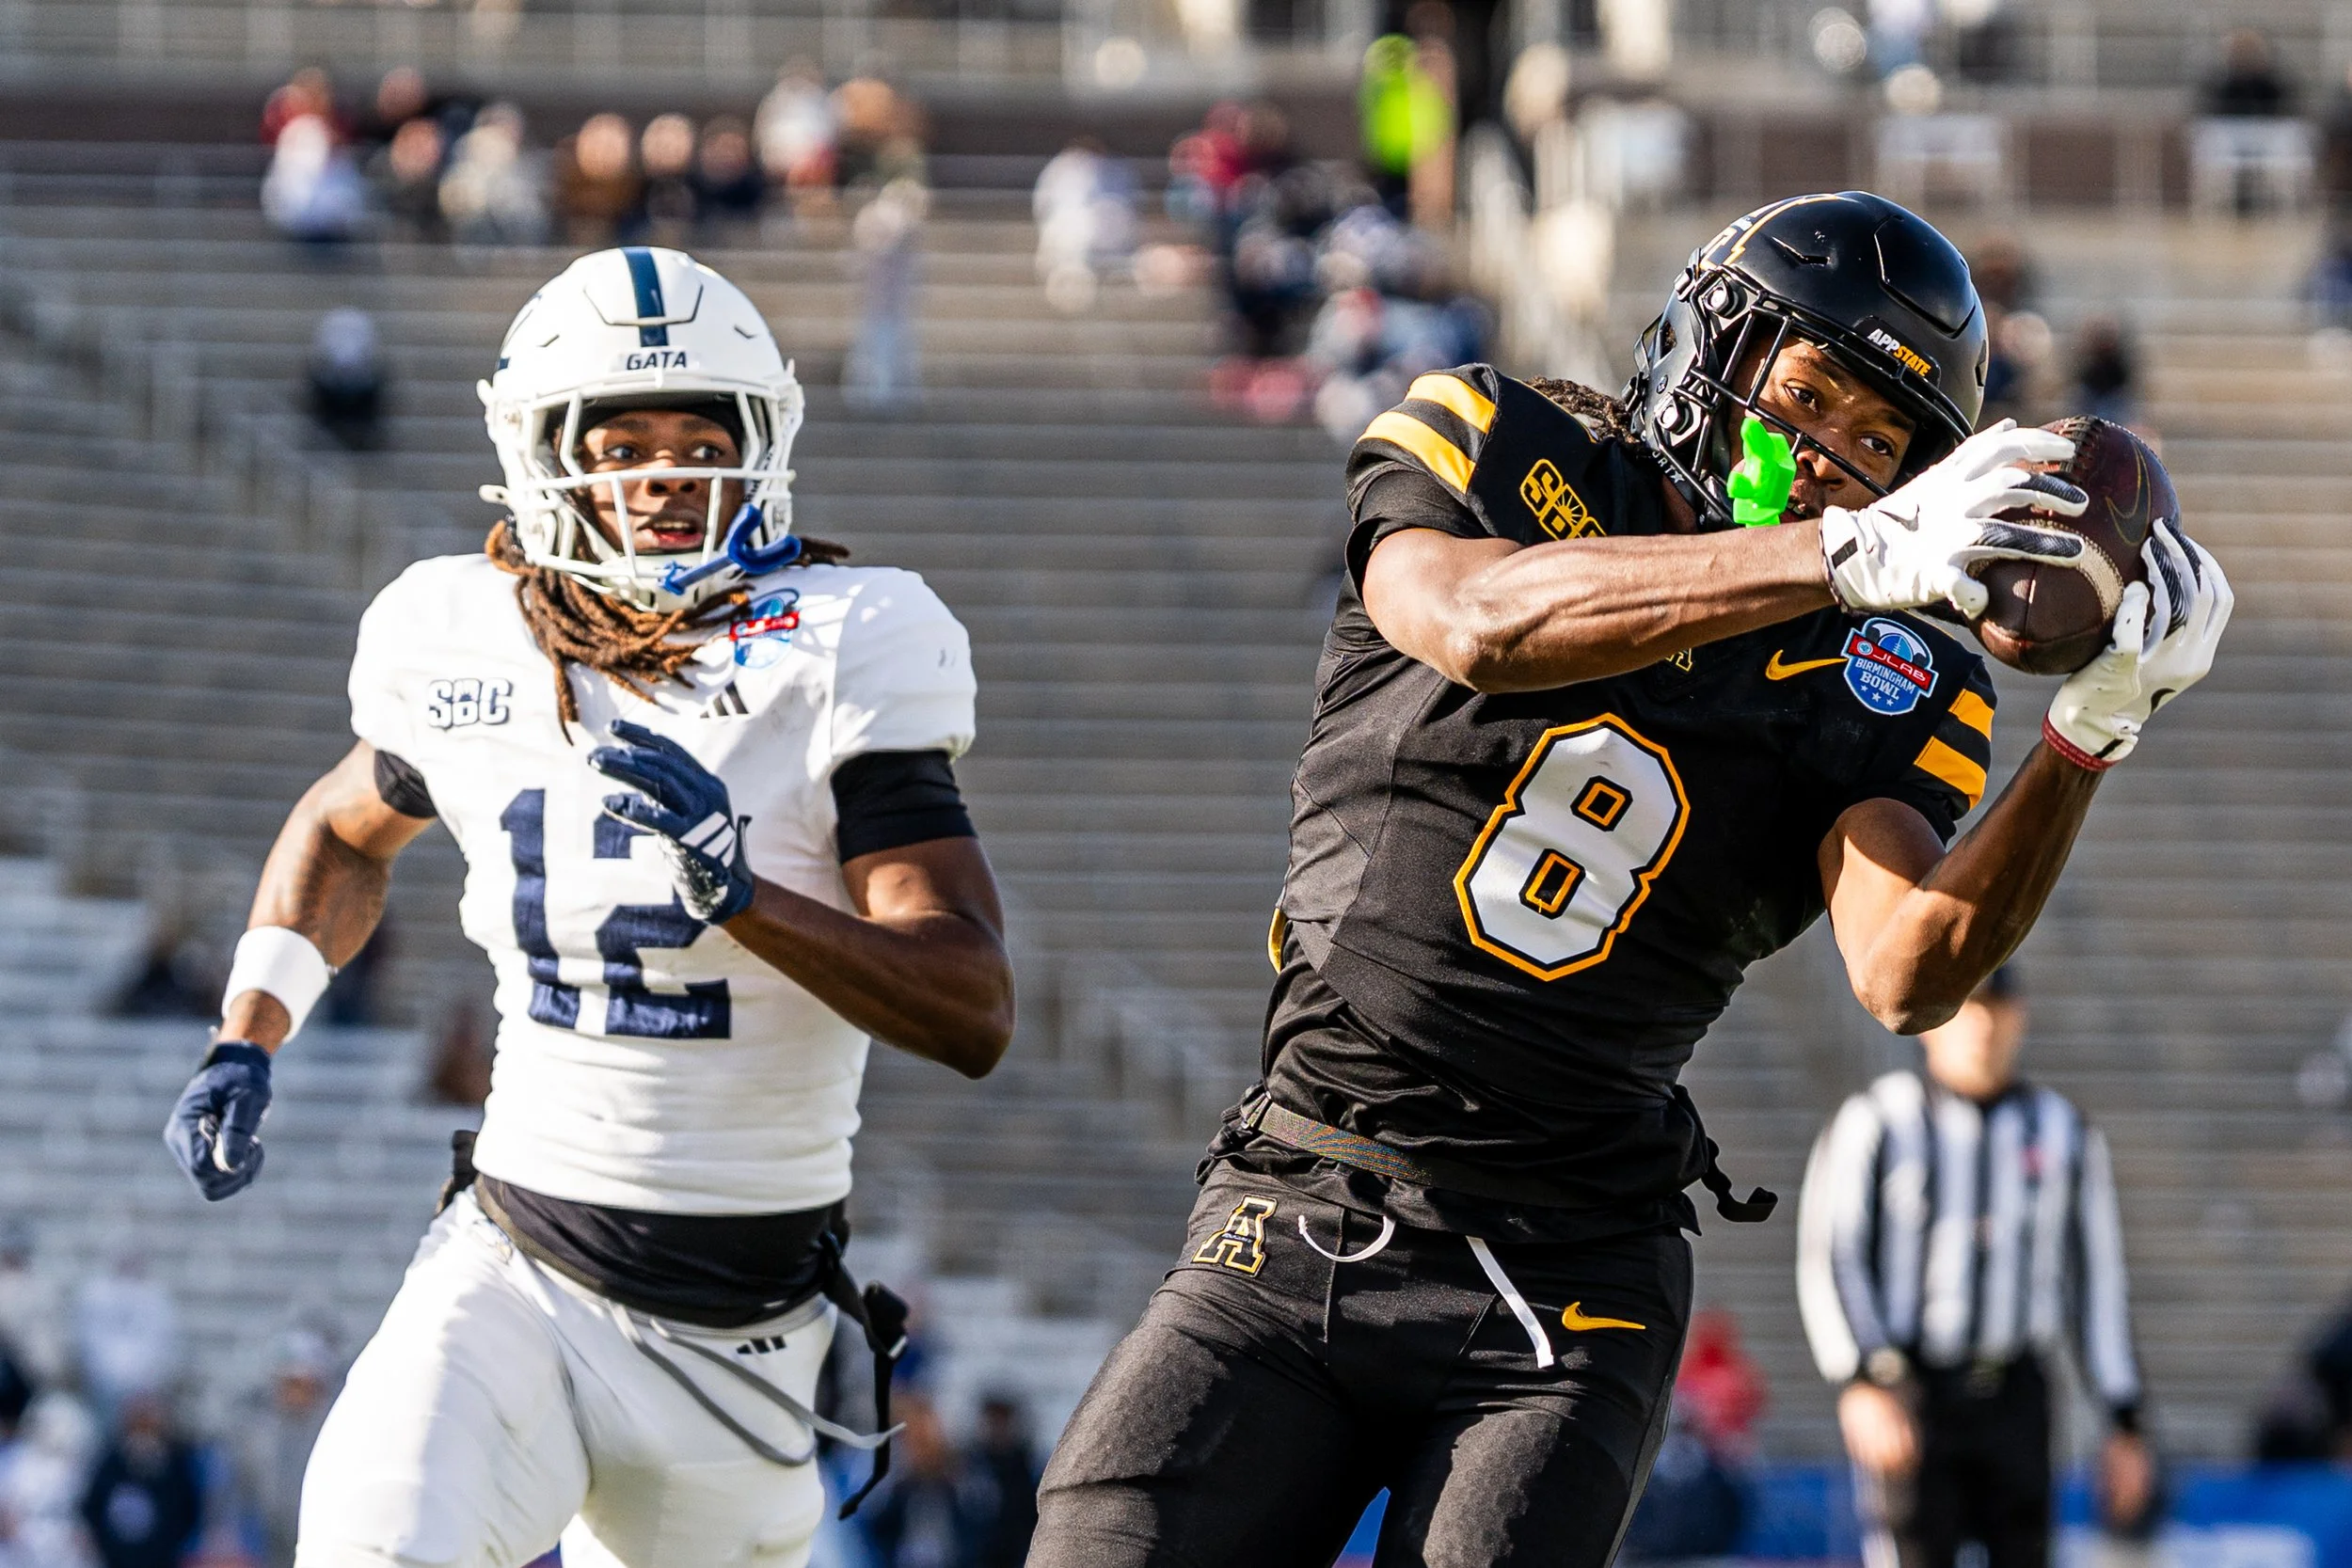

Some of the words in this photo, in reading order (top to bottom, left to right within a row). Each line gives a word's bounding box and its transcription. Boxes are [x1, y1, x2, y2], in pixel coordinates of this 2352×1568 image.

[626, 351, 687, 371] GATA
[1855, 658, 1916, 694] BIRMINGHAM
[1860, 671, 1900, 700] BOWL
[1872, 654, 1926, 681] JLAB
[428, 677, 514, 730] SBC
[1454, 712, 1691, 982] 8
[500, 788, 732, 1039] 12
[1192, 1194, 1278, 1275] A
